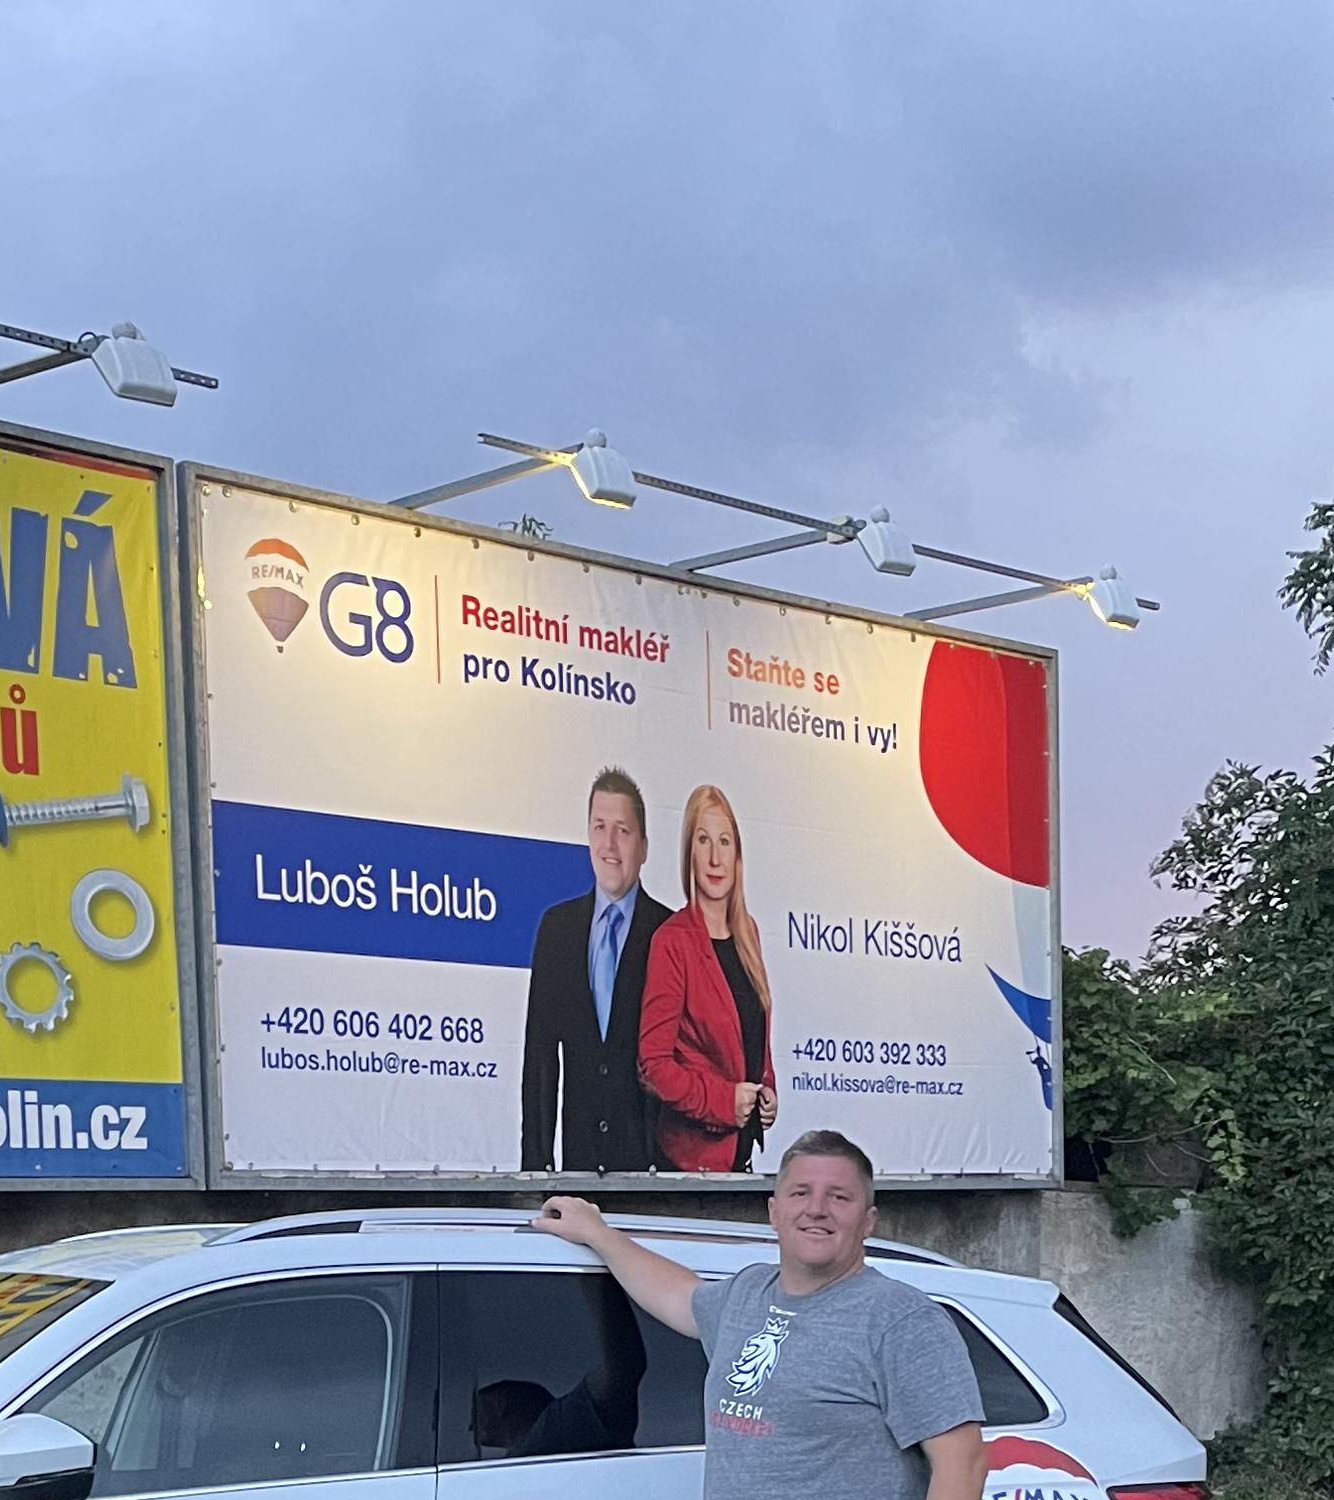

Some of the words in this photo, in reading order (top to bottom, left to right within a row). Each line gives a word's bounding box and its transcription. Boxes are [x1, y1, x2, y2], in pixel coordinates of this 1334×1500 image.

[251, 563, 305, 590] RE/MAX
[319, 571, 415, 664] G8
[462, 594, 569, 644] Realitní
[579, 625, 671, 663] makléř
[463, 653, 510, 684] pro
[521, 656, 637, 706] Kolínsko
[727, 647, 806, 690] Staňte
[814, 671, 841, 695] se
[729, 699, 846, 742] makléřem
[853, 715, 860, 744] i
[867, 723, 898, 754] vy!
[255, 853, 377, 911] Luboš
[390, 868, 497, 922] Holub
[788, 911, 853, 954] Nikol
[864, 919, 962, 963] Kiššová
[260, 1006, 324, 1036] +420
[333, 1009, 380, 1038] 606
[388, 1013, 433, 1041] 402
[440, 1016, 485, 1043] 668
[261, 1046, 498, 1078] lubos.holub@re-max.cz
[792, 1038, 837, 1062] +420
[842, 1041, 874, 1064] 603
[880, 1042, 911, 1066] 392
[916, 1044, 947, 1067] 333
[792, 1071, 964, 1096] nikol.kissova@re-max.cz
[719, 1398, 763, 1420] CZECH
